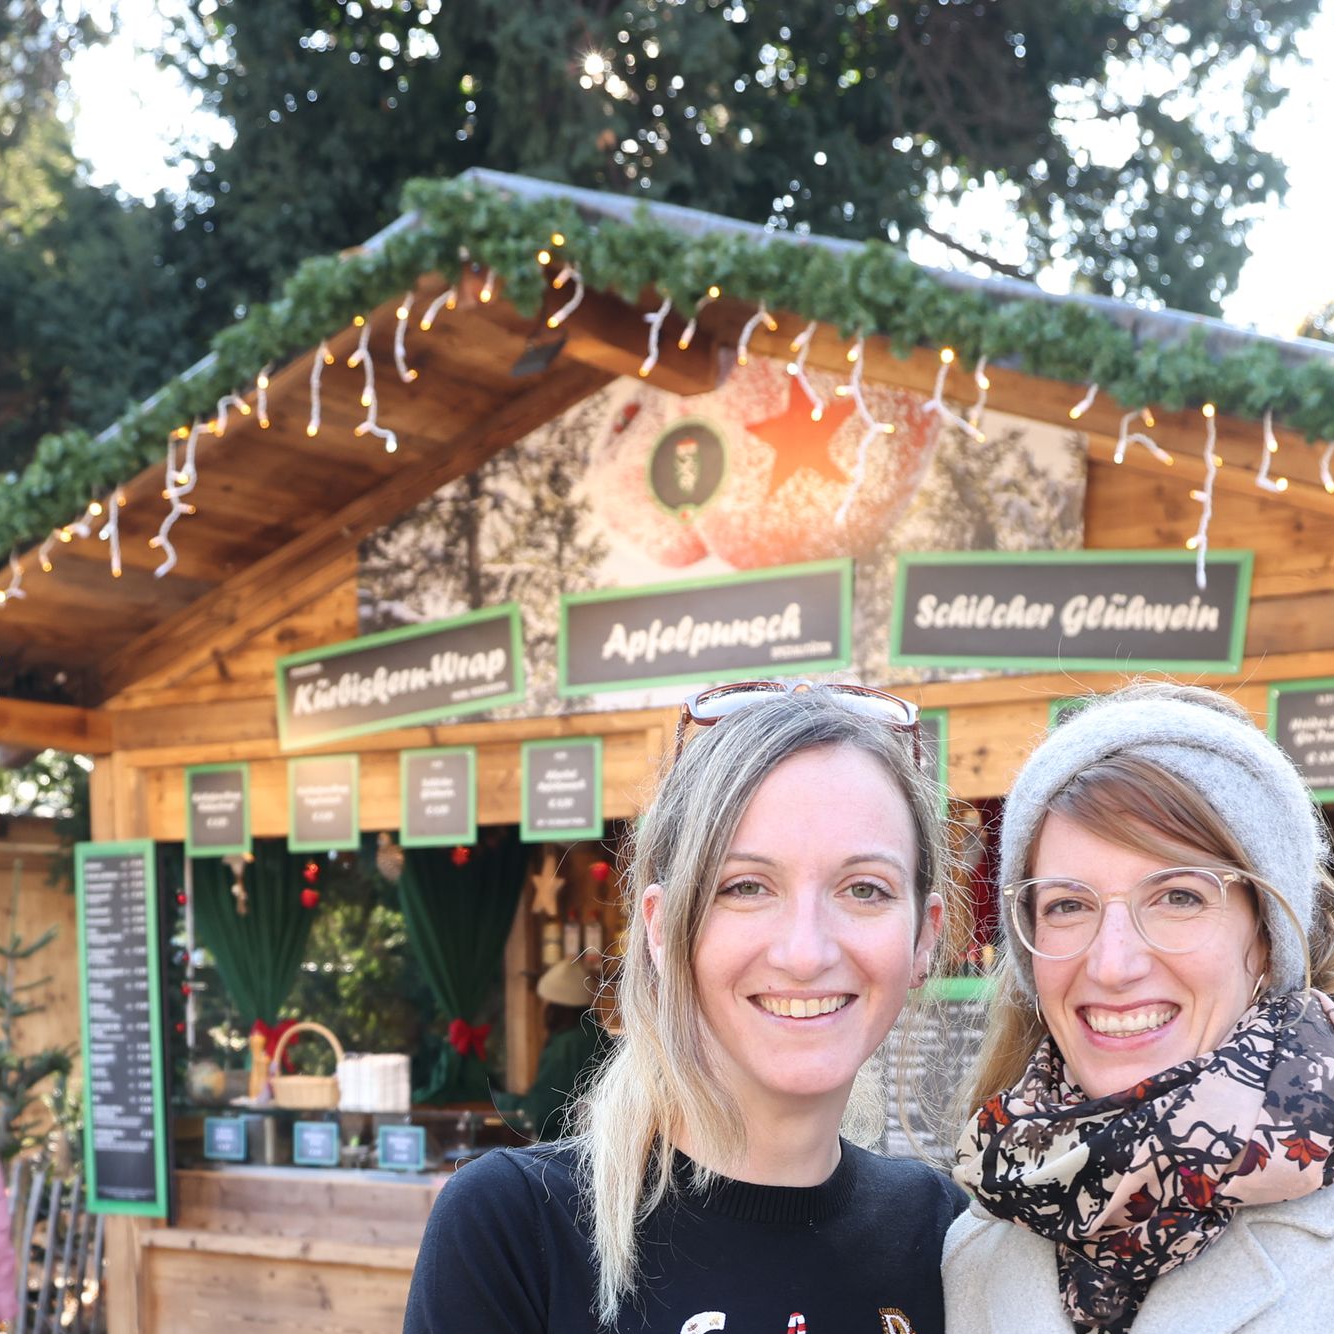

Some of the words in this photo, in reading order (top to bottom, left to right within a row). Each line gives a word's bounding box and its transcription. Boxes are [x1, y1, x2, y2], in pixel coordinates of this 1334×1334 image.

[601, 602, 802, 665] Apfelpunsch
[915, 594, 1055, 630] Schilcher
[1060, 593, 1220, 638] Glühwein
